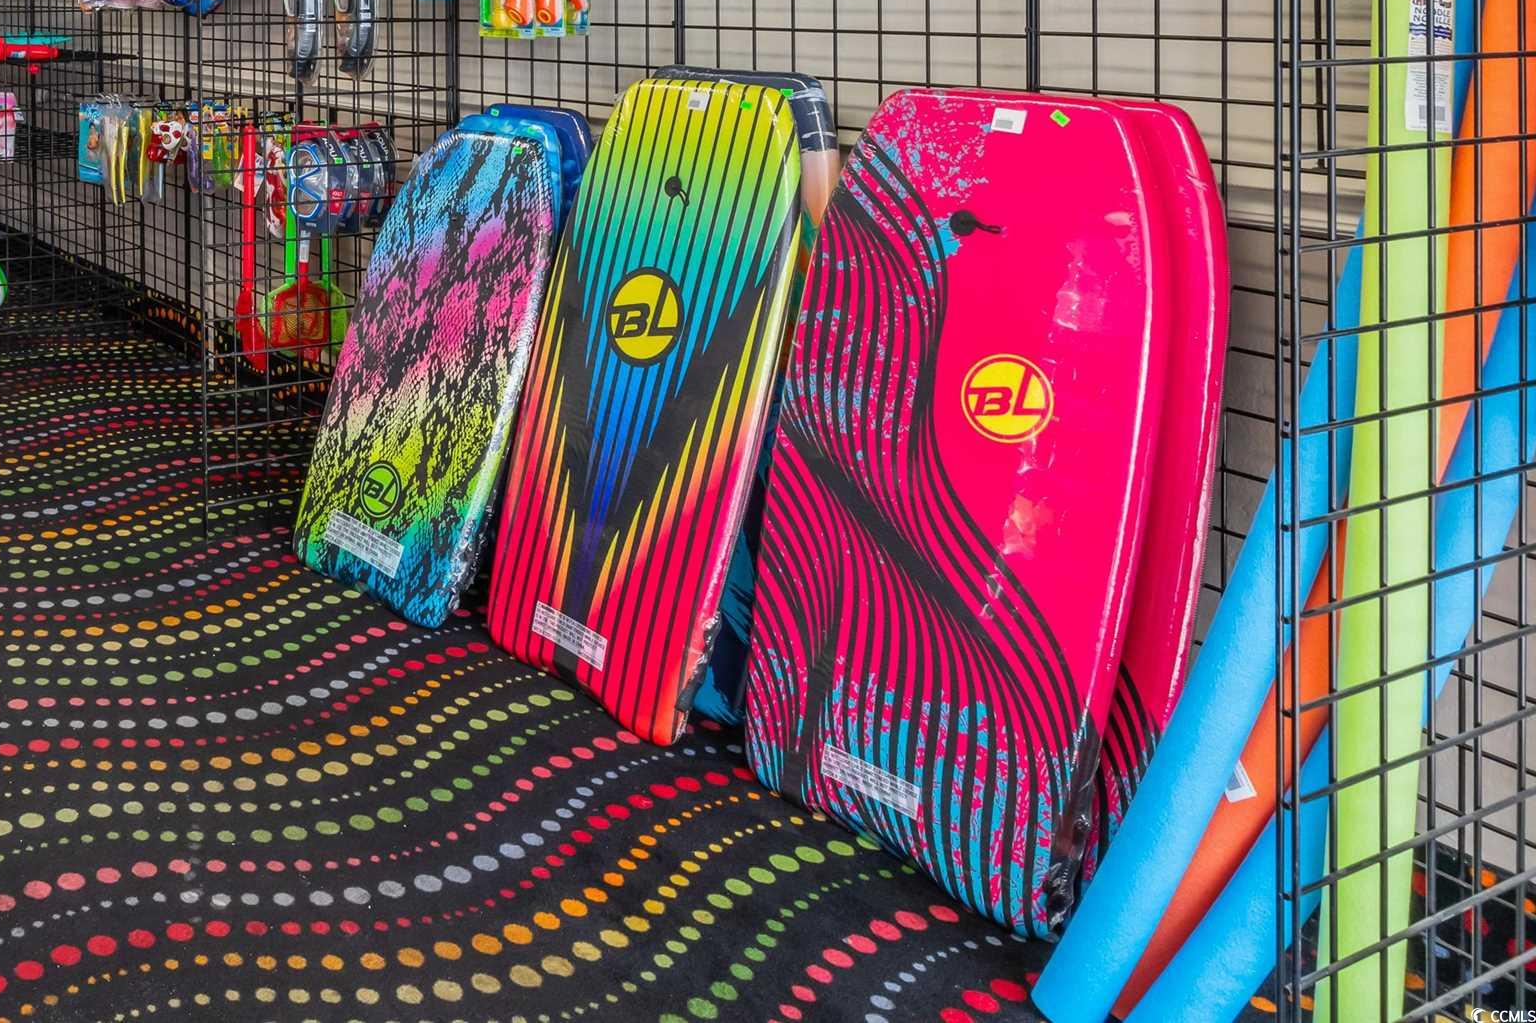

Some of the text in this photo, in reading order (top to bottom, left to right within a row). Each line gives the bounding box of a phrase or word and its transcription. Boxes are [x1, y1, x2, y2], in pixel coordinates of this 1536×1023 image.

[611, 278, 677, 338] BL
[967, 366, 1048, 417] BL
[364, 477, 398, 507] BL
